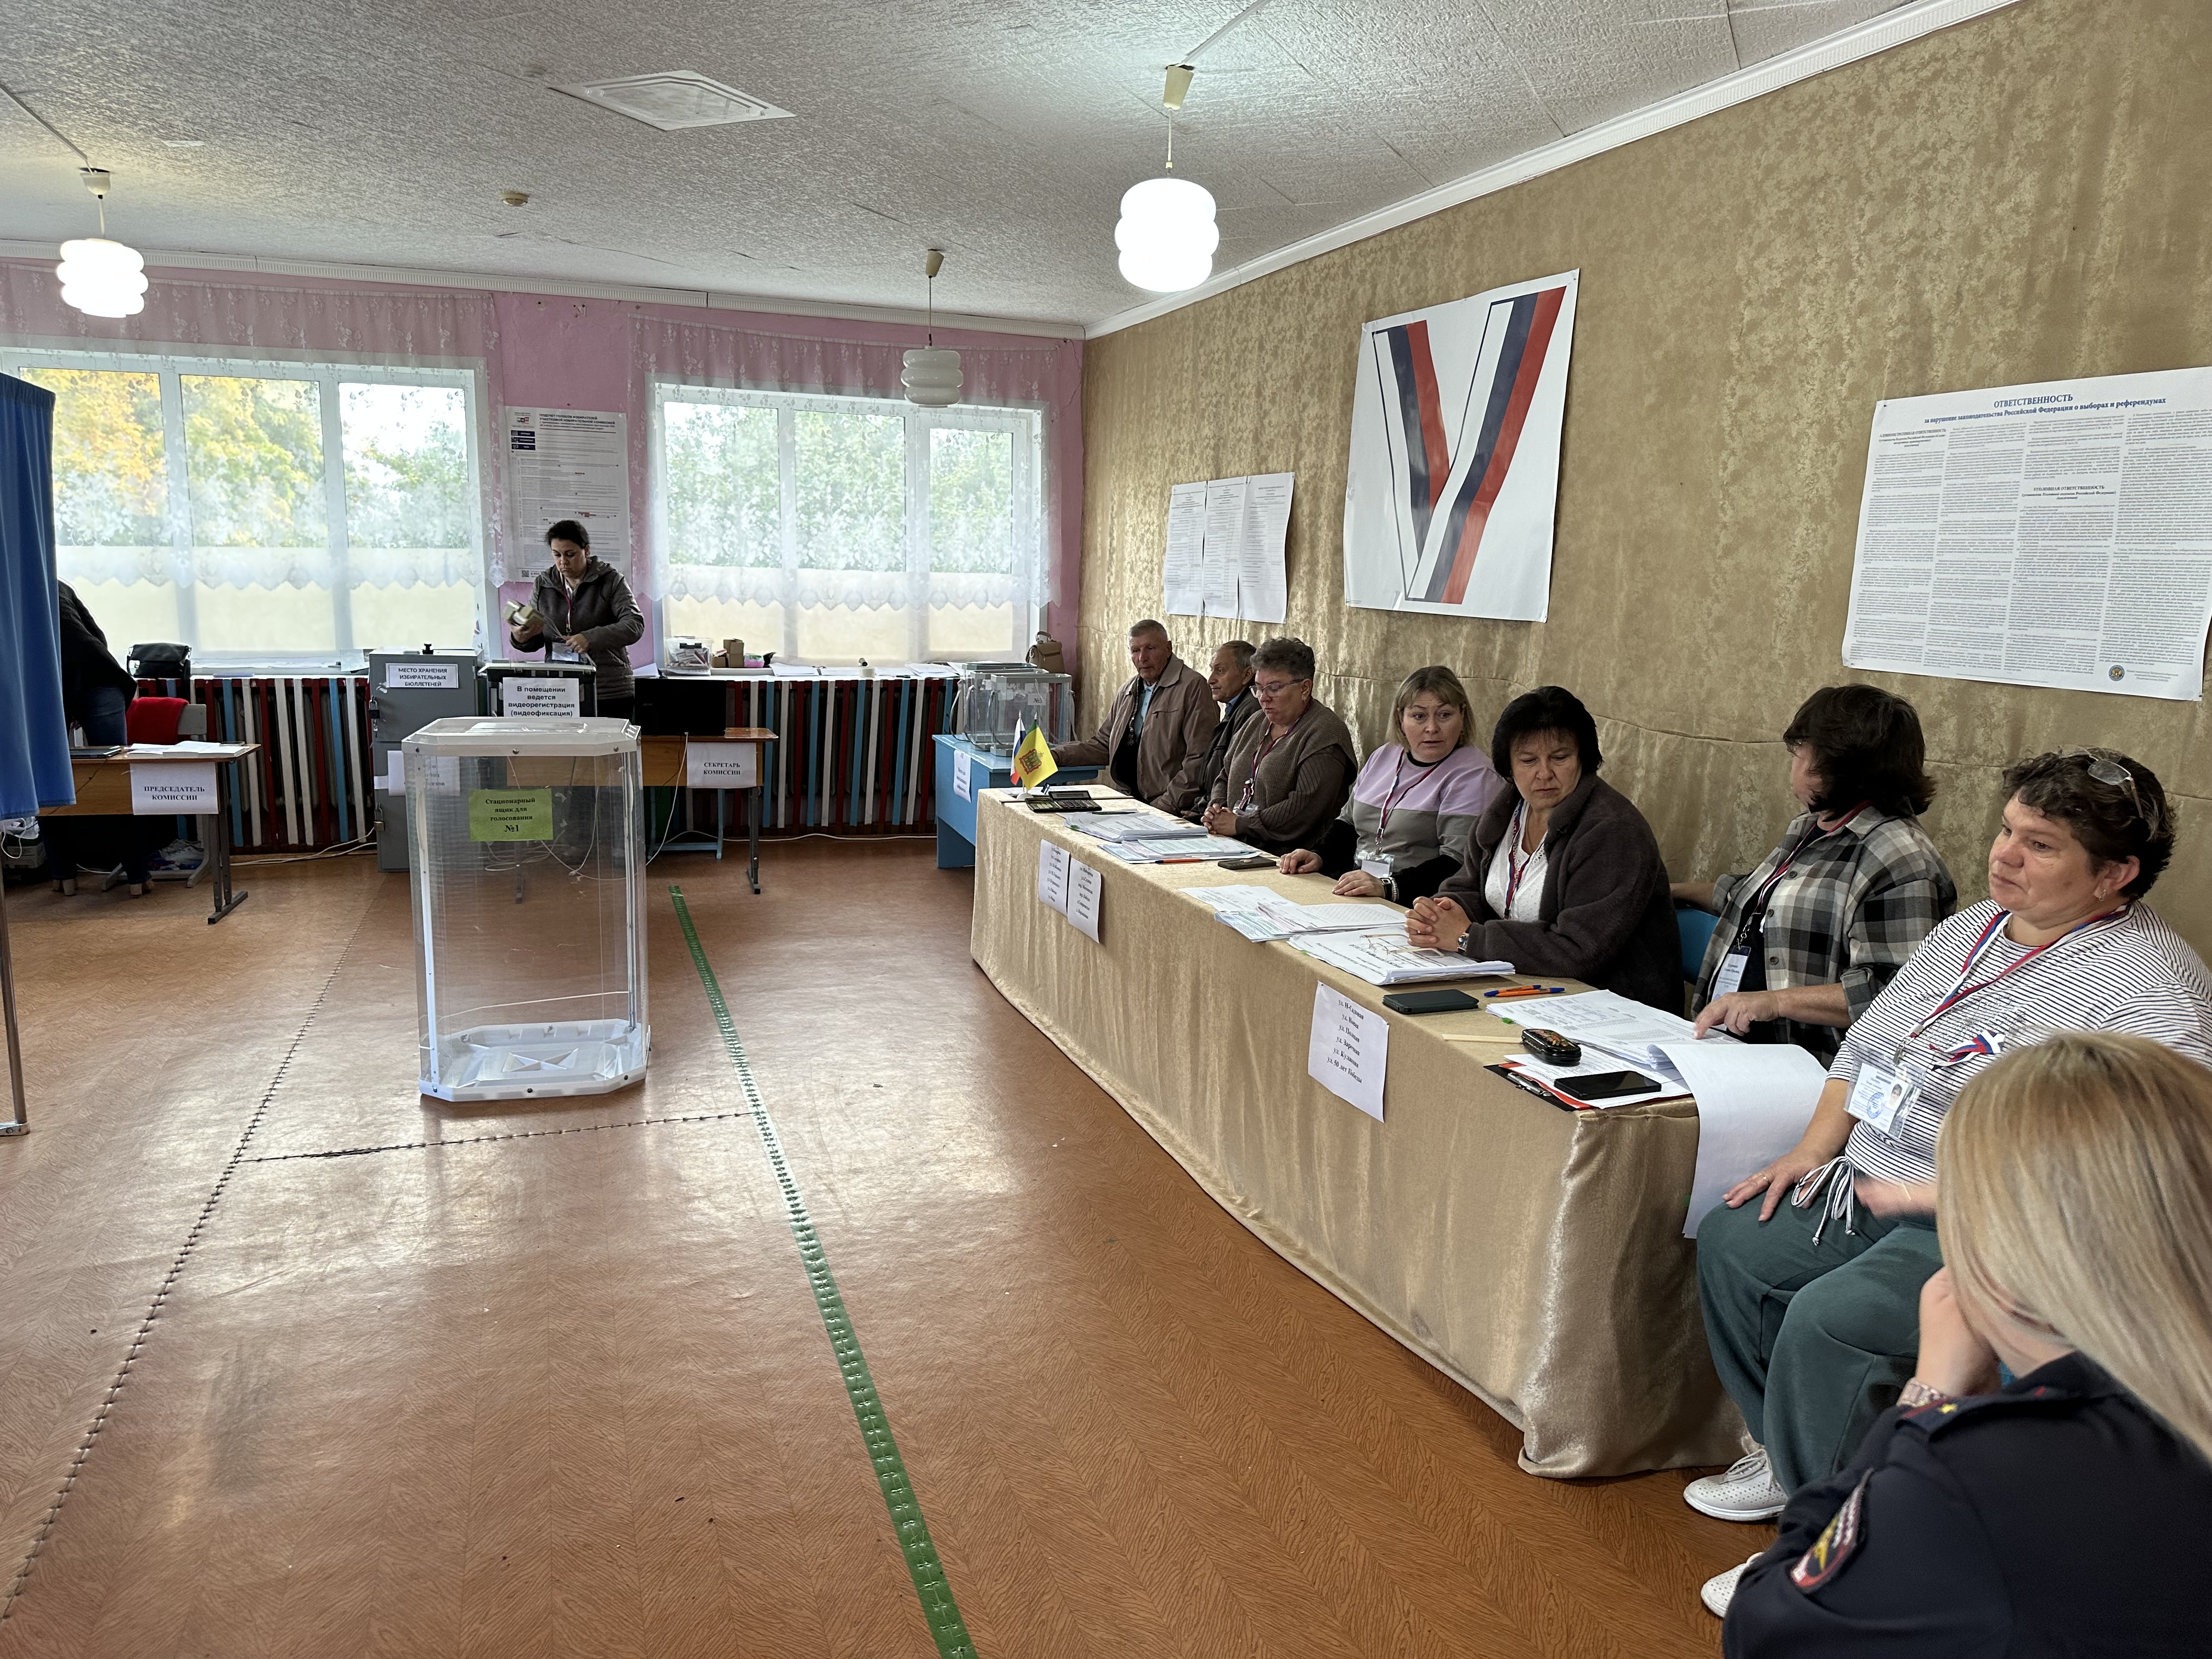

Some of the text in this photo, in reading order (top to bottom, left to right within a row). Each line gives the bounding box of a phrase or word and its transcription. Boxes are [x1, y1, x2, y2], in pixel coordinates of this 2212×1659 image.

[1957, 411, 2002, 420] законодательства
[2004, 408, 2036, 416] Российской
[2116, 398, 2166, 409] референдумах
[1994, 394, 2073, 408] ОТВЕТСТВЕННОСТЬ
